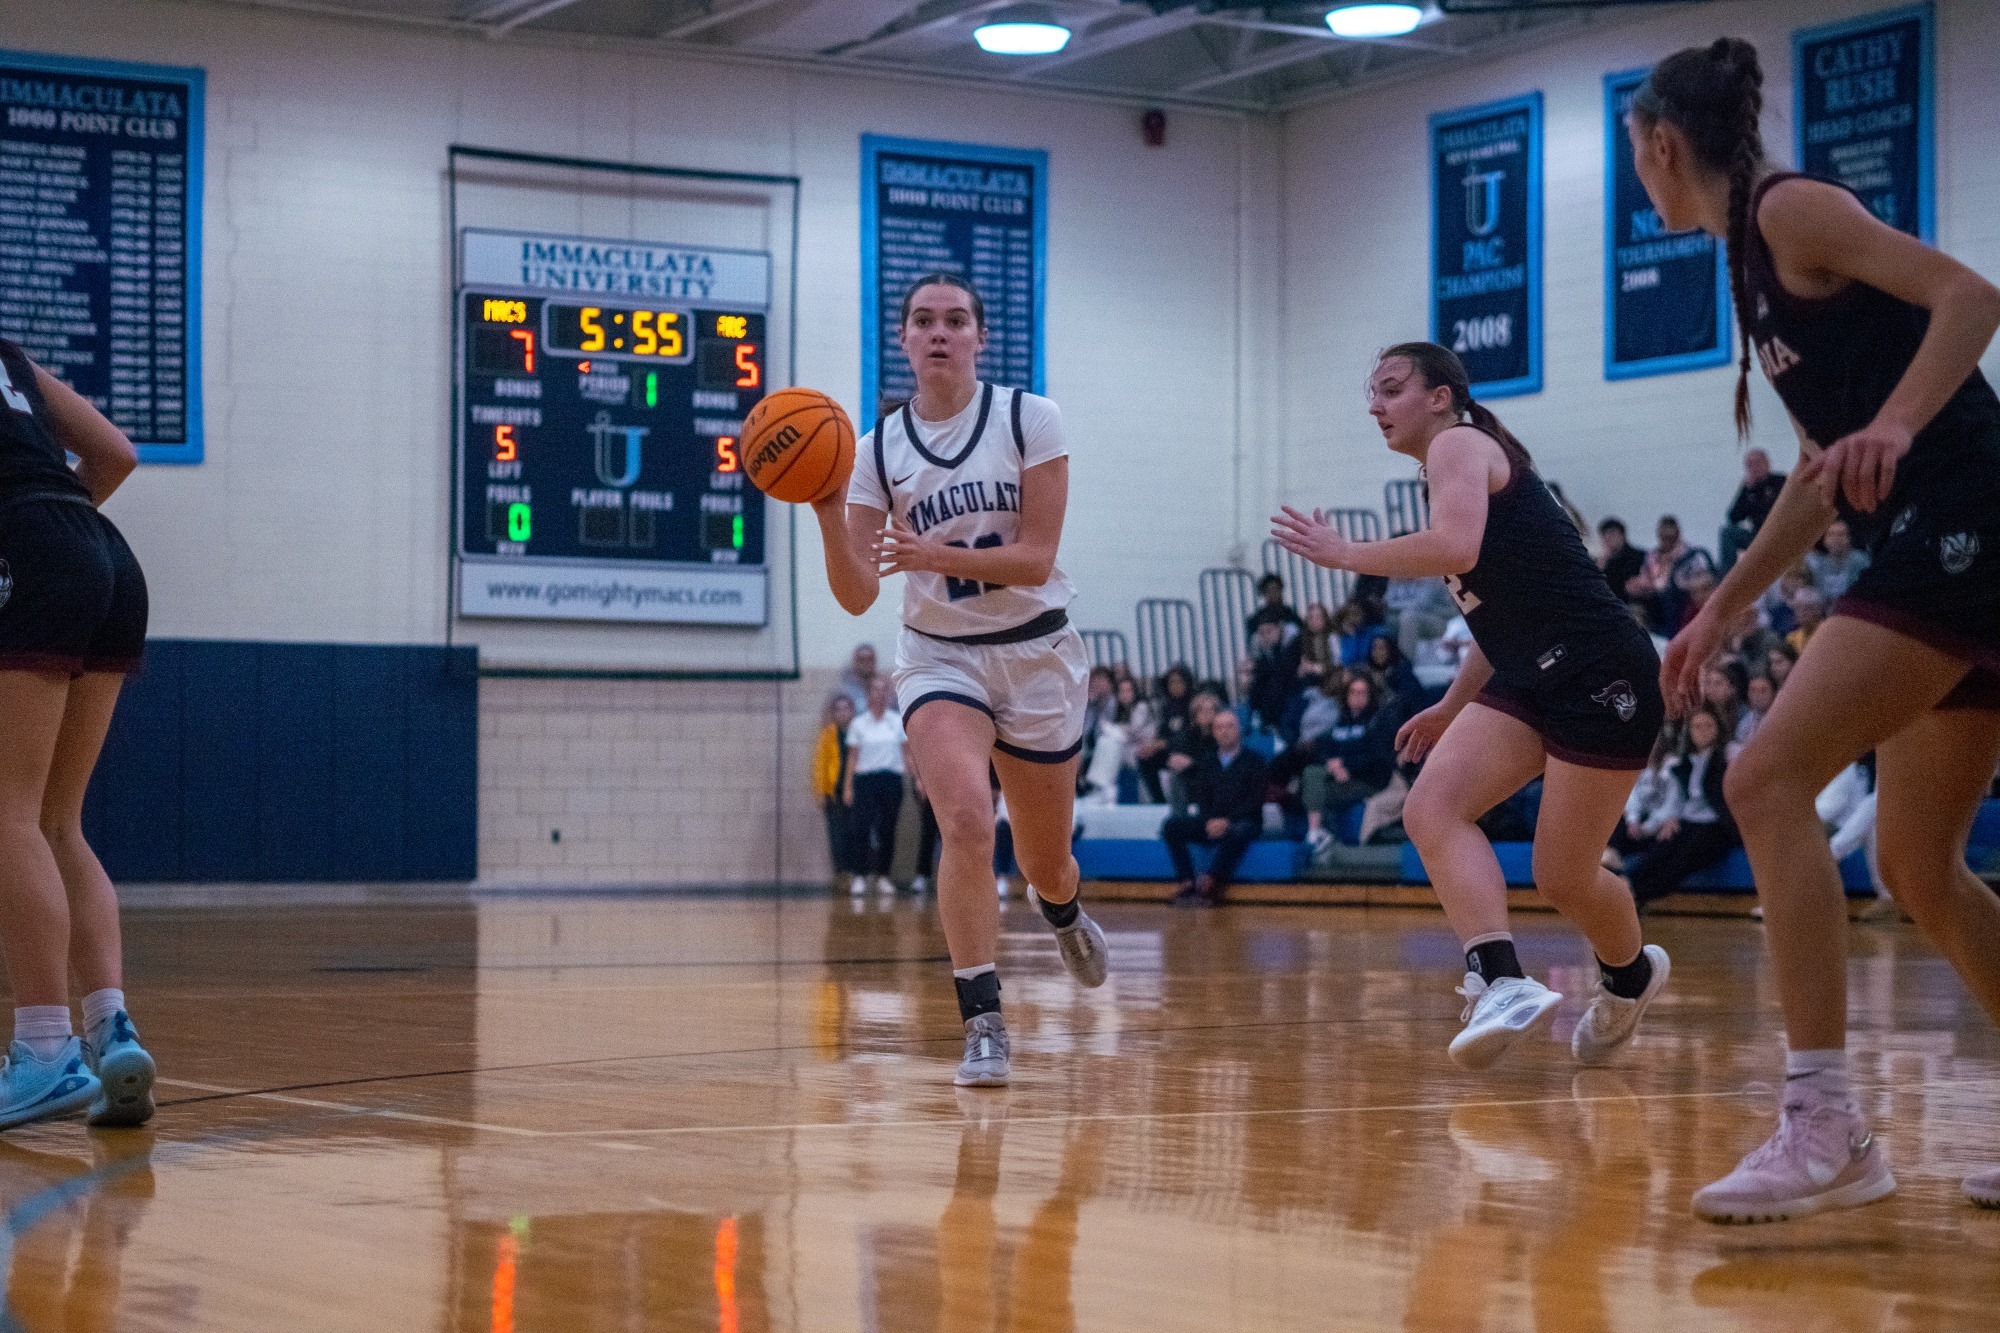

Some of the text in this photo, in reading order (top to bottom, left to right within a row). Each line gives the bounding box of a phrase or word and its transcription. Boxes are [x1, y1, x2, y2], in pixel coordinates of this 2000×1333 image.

[0, 78, 183, 118] IMMACULATA
[61, 111, 121, 136] POINT
[125, 117, 178, 140] CLUB
[521, 241, 714, 276] IMMACULATA
[521, 265, 714, 299] UNIVERSITY
[580, 307, 682, 356] 5:55
[1452, 313, 1513, 354] 2008
[510, 329, 534, 373] 7
[735, 344, 760, 388] 5
[645, 372, 658, 408] 1
[496, 425, 517, 461] 5
[717, 437, 738, 472] 5
[508, 503, 532, 541] 0
[732, 515, 744, 548] 1
[486, 579, 743, 608] www.gomightymacs.com
